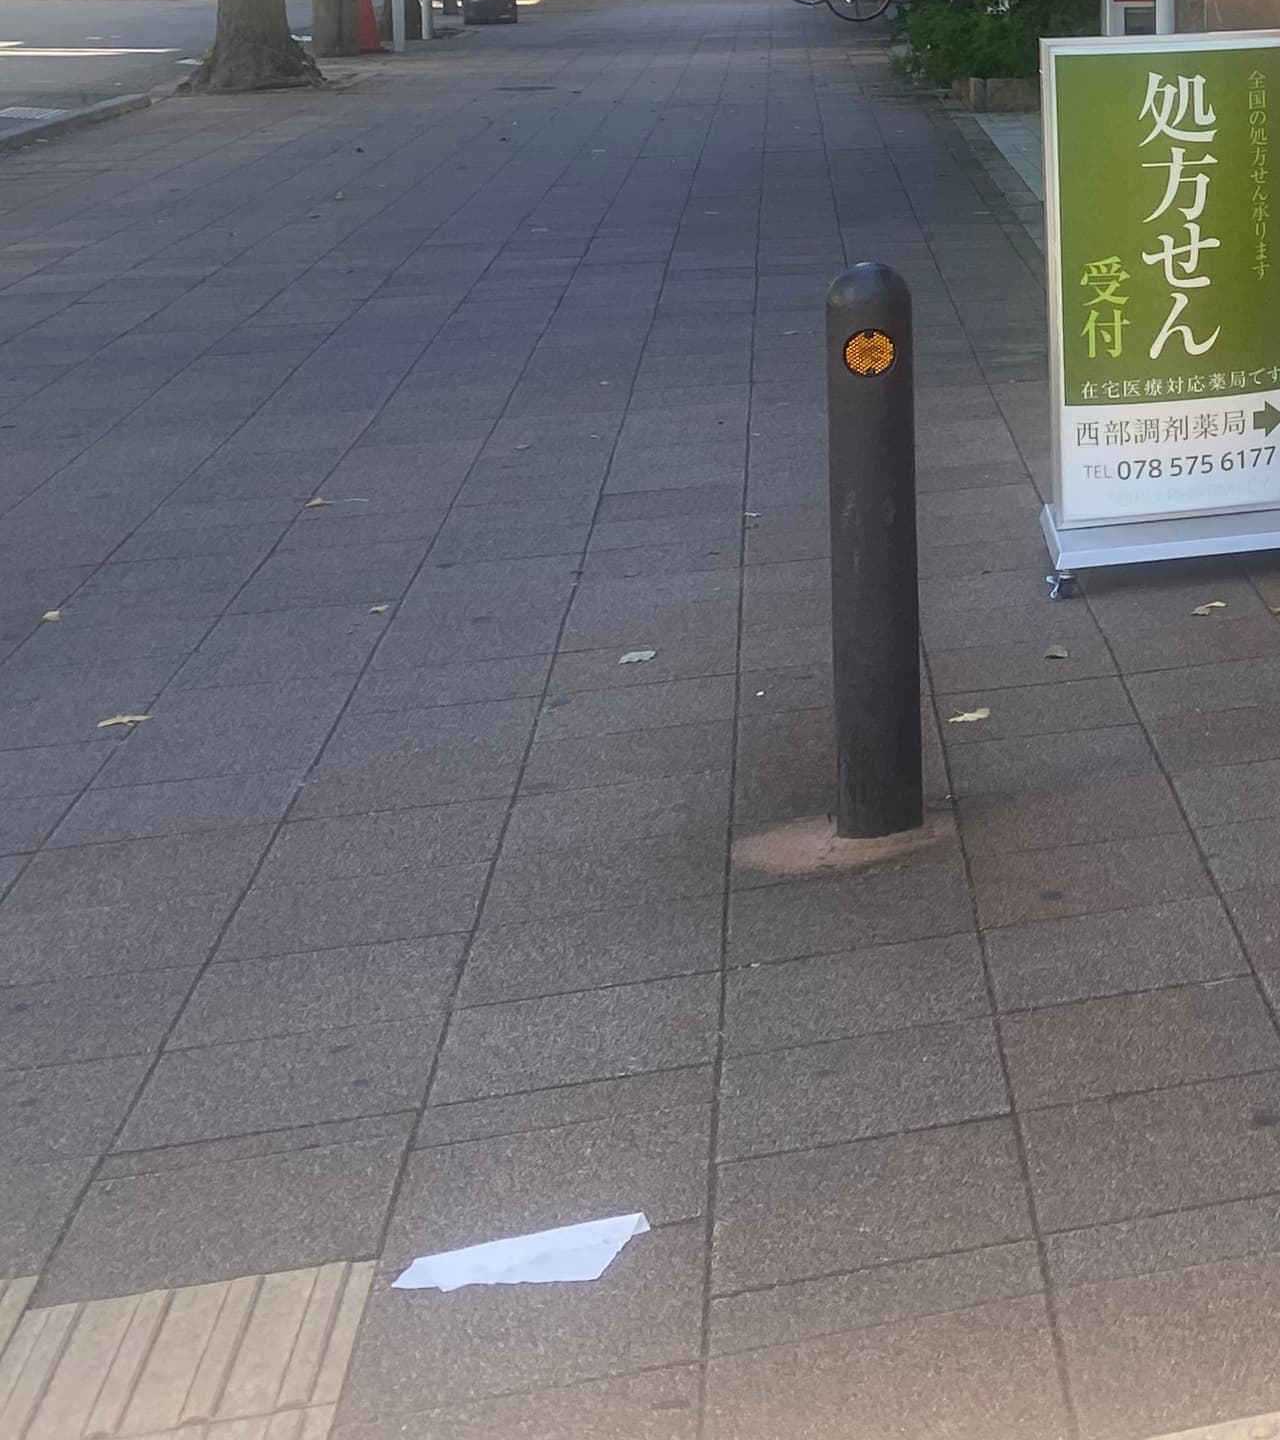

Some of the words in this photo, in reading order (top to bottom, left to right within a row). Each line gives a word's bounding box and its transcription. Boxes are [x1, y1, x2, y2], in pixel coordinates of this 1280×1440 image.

[1138, 71, 1222, 361] 処方せん
[1248, 69, 1271, 280] 全国の処方せん承ります
[1080, 255, 1131, 359] 受付
[1075, 409, 1248, 447] 西部調剤薬局
[1083, 463, 1113, 479] TEL
[1117, 459, 1163, 480] 078
[1170, 453, 1214, 477] 575
[1220, 446, 1278, 472] 6177
